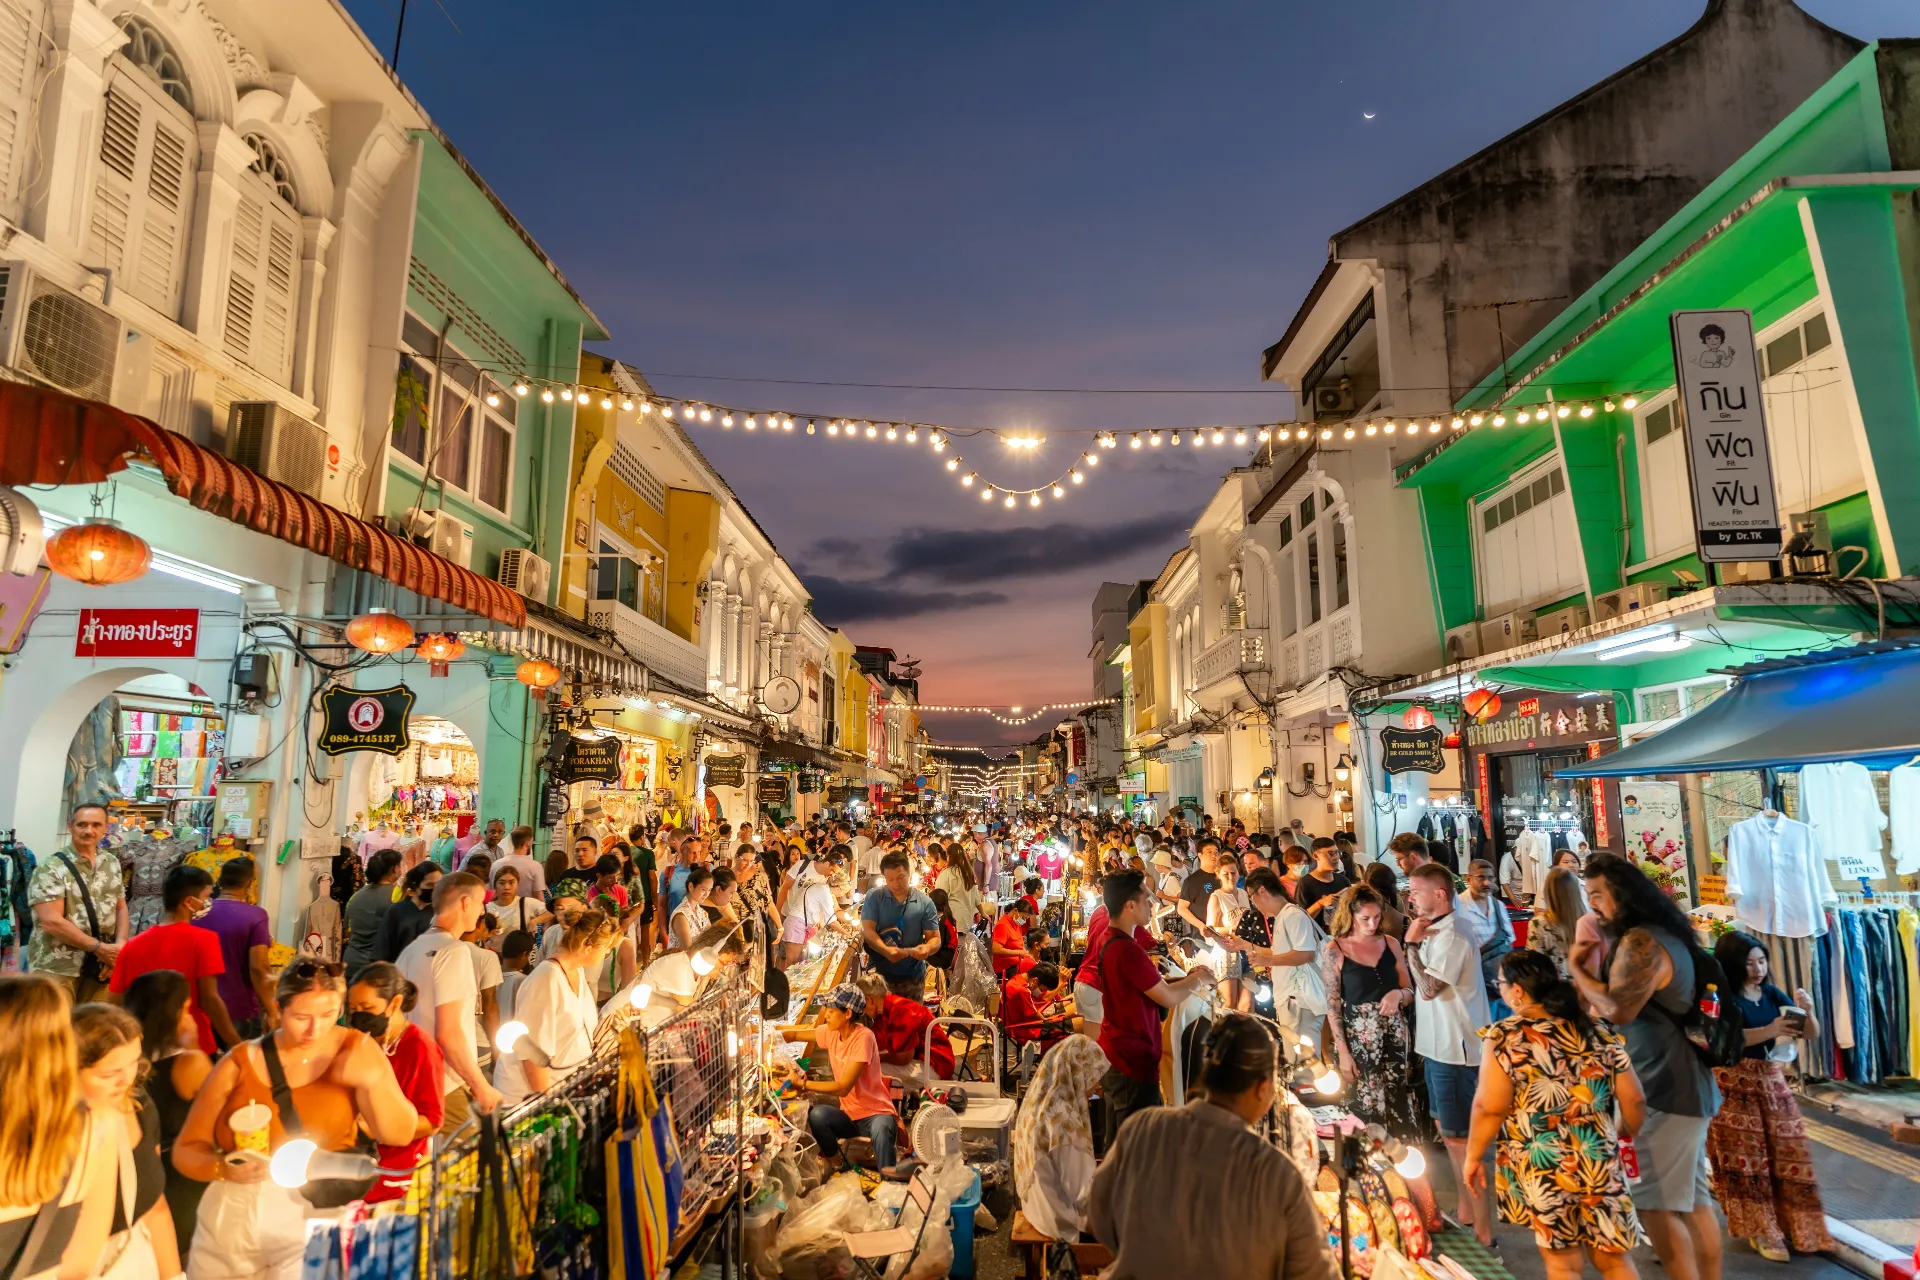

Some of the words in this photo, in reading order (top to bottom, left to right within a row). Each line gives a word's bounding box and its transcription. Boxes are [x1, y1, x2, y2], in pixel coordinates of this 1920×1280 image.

[1719, 532, 1732, 543] by
[82, 617, 193, 648] ห้างทองประยูร
[329, 734, 397, 743] 089-4745137
[1848, 866, 1880, 875] LINEN
